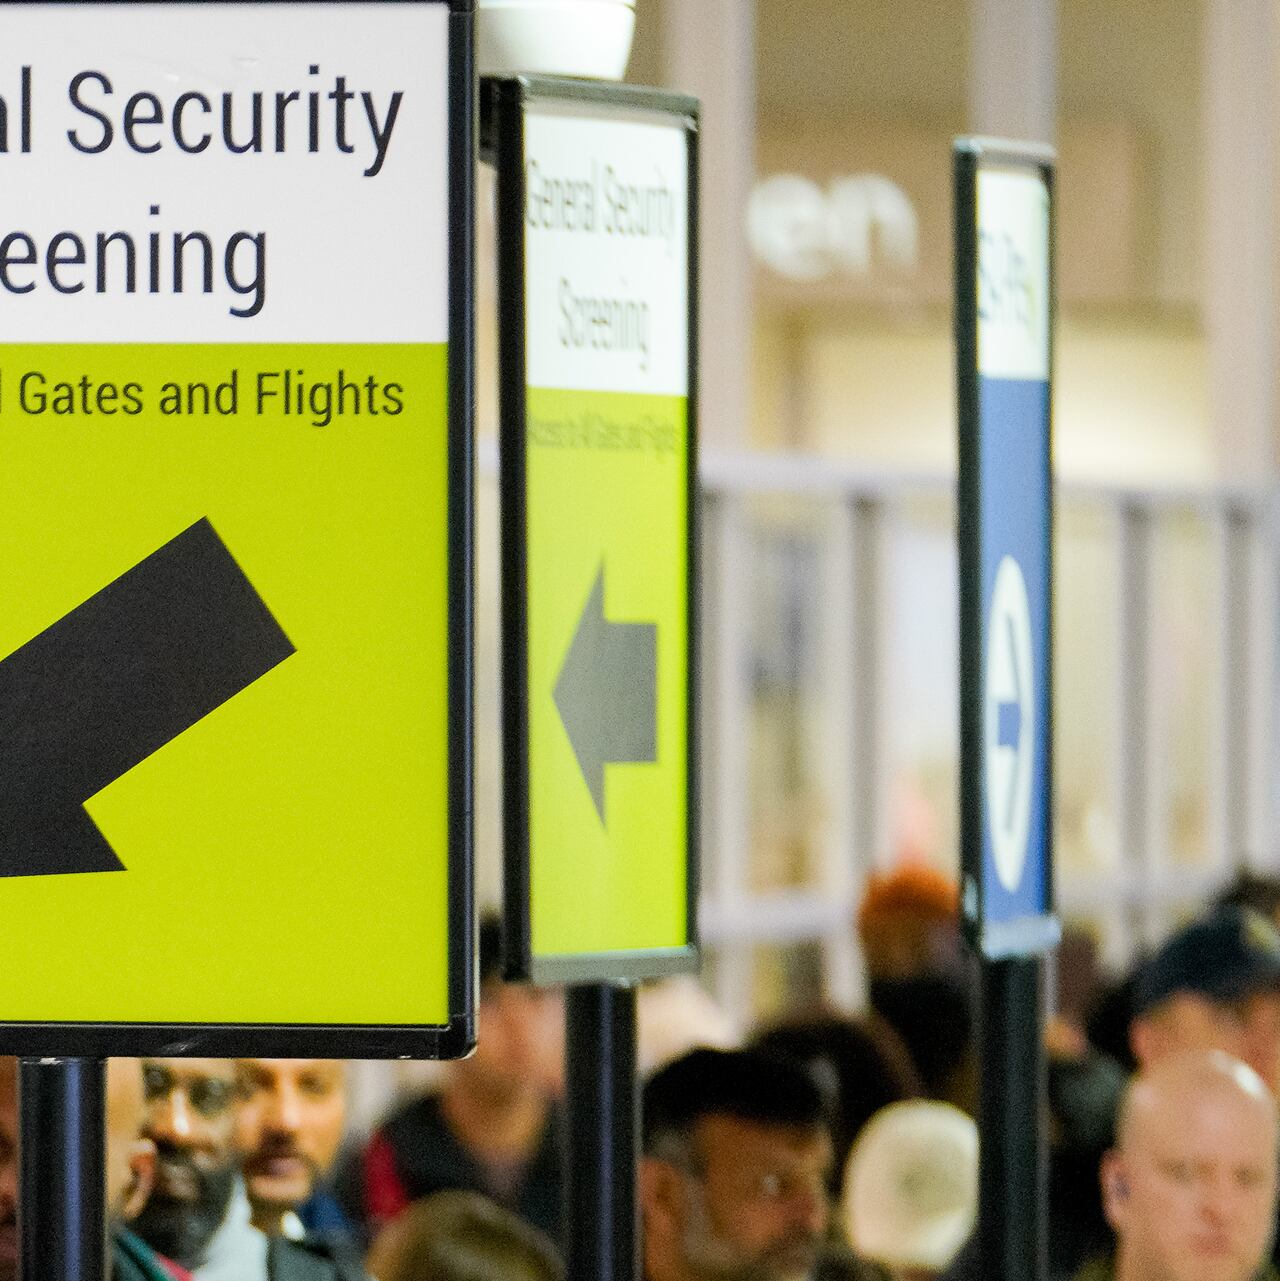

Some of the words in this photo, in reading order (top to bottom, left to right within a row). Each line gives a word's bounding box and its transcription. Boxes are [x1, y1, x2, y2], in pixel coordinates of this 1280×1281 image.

[66, 64, 404, 178] Security
[18, 371, 144, 416] Gates
[158, 368, 240, 416] and
[255, 368, 405, 428] Flights
